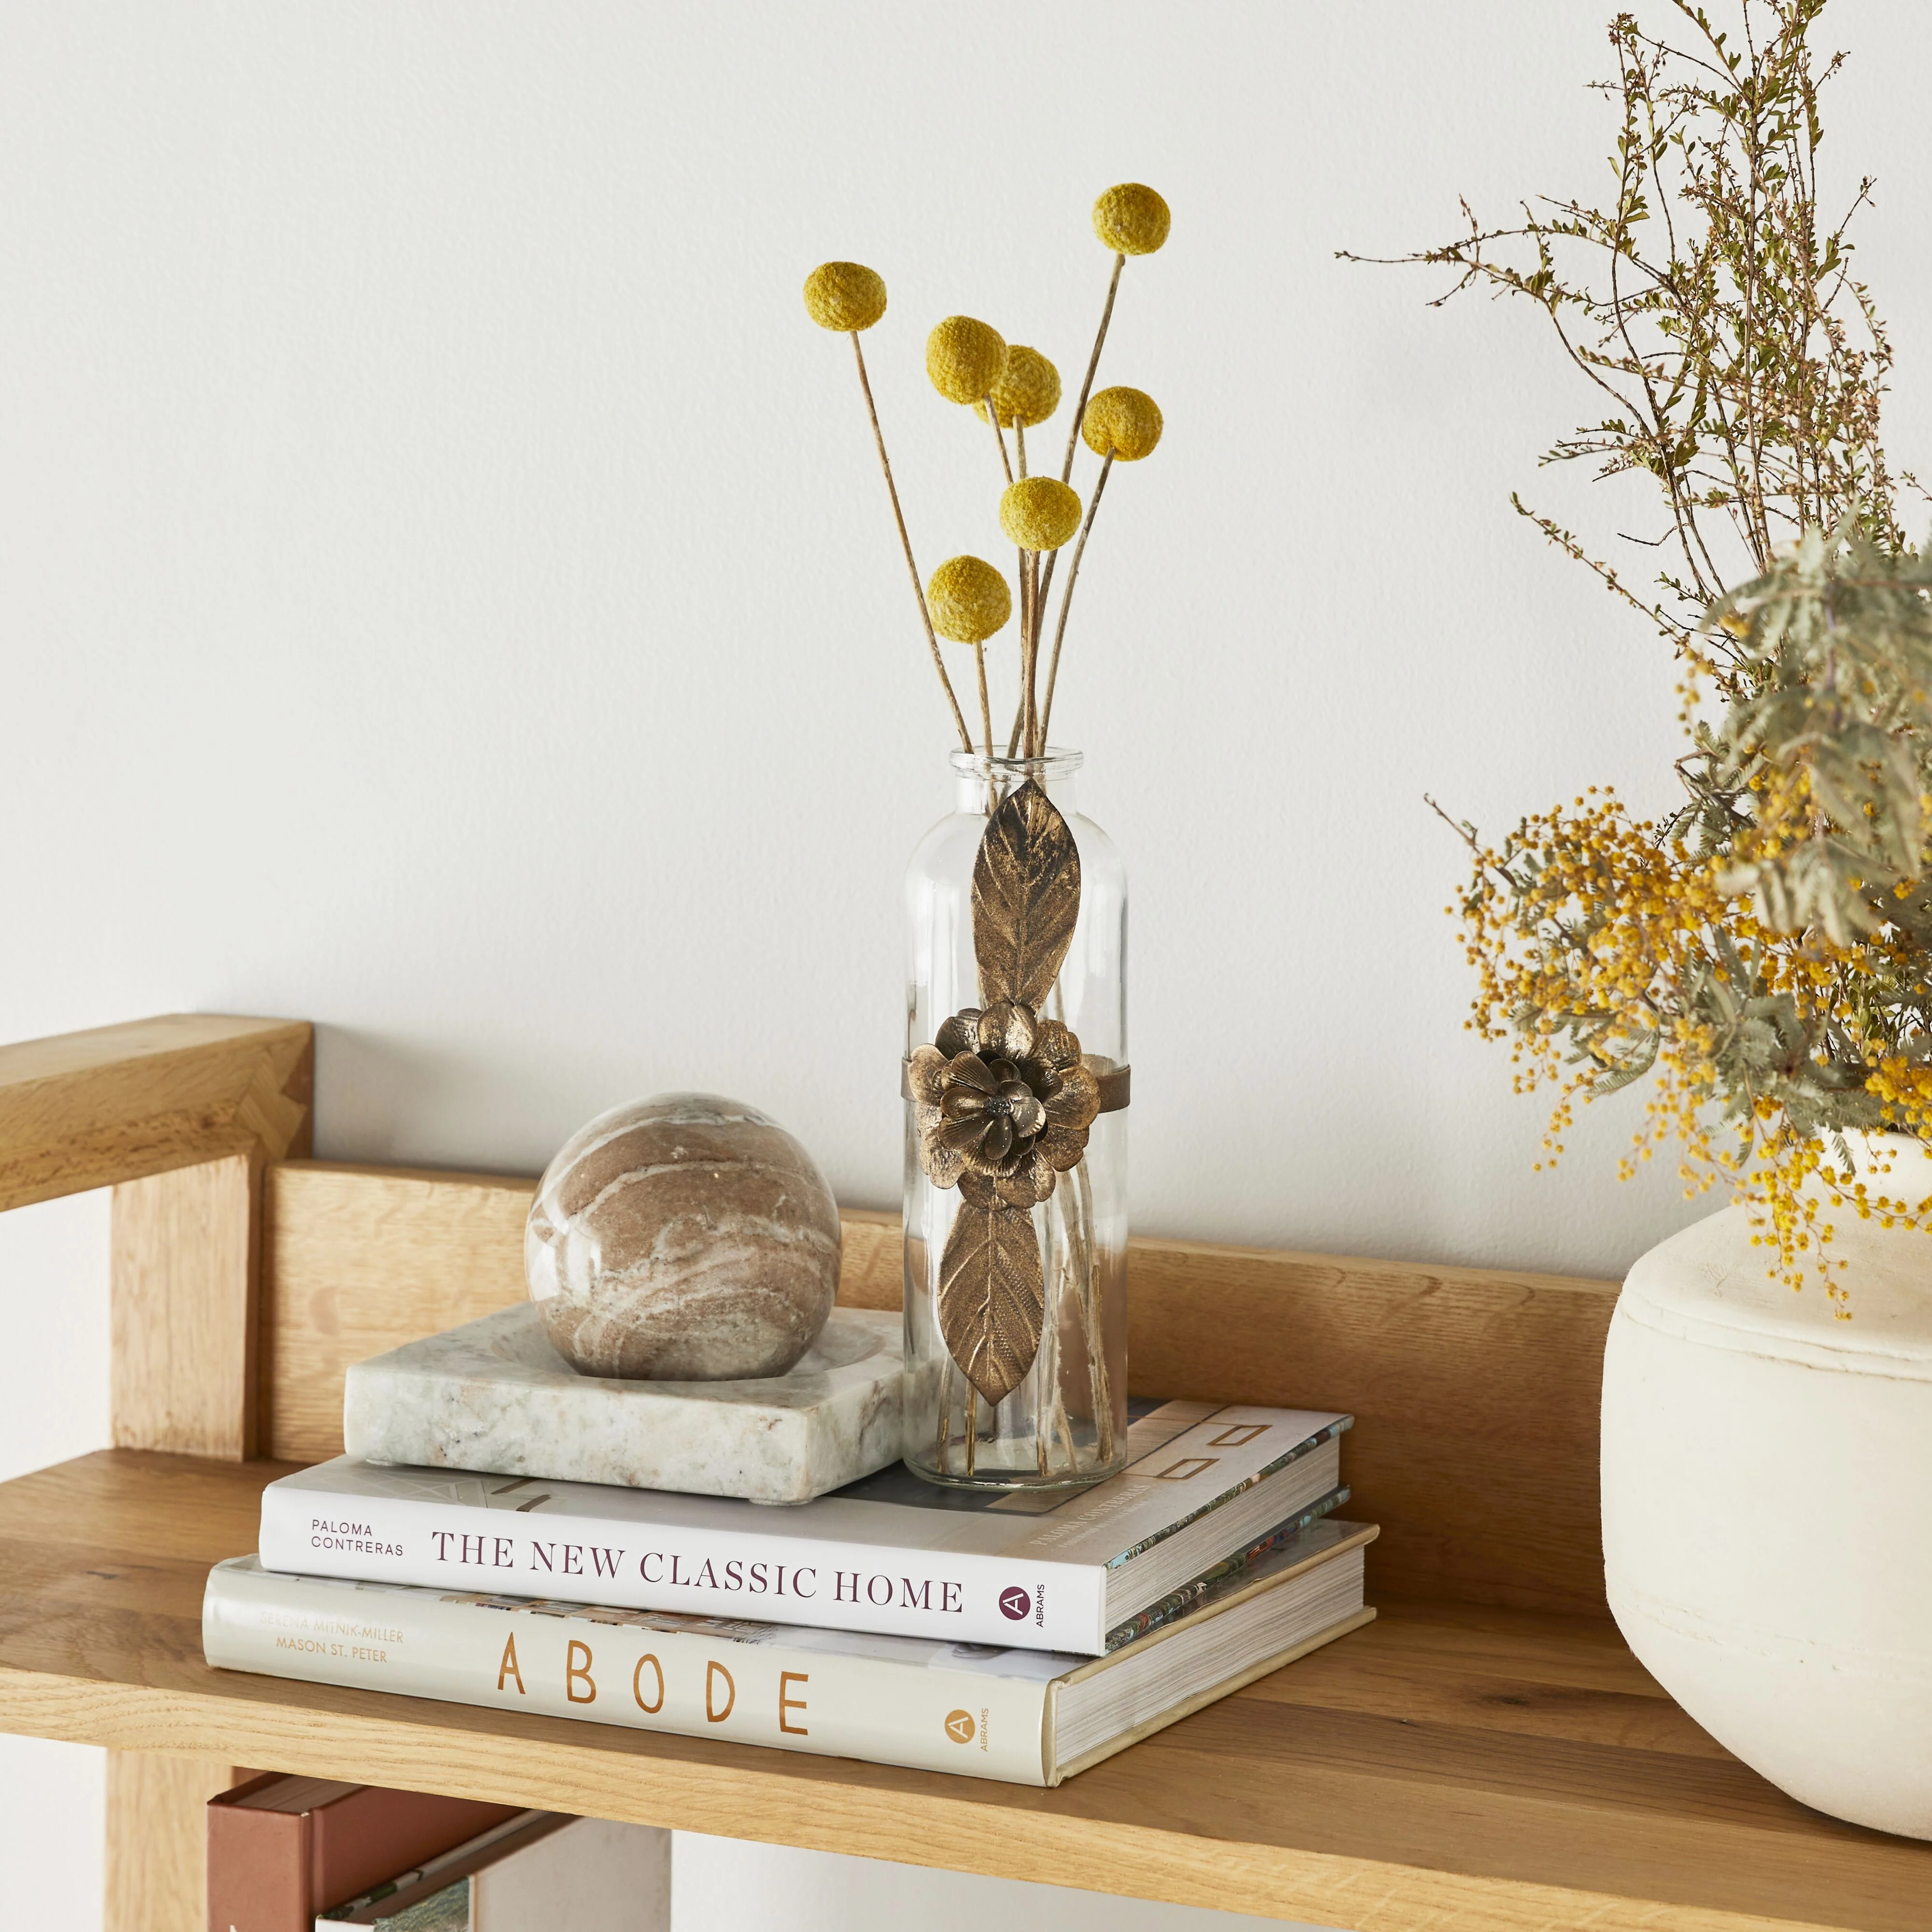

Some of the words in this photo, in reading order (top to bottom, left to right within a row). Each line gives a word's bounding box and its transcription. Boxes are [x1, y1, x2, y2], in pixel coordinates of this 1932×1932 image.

[312, 1519, 372, 1537] PALOMA
[1030, 1521, 1087, 1546] PALOMA
[1078, 1484, 1151, 1520] CONTRERAS
[311, 1536, 403, 1556] CONTRERAS
[431, 1531, 514, 1568] THE
[529, 1541, 626, 1579] NEW
[640, 1552, 817, 1598] CLASSIC
[833, 1571, 963, 1613] HOME
[261, 1611, 309, 1630] SERENA
[313, 1619, 404, 1644] MITNIK-MILLER
[1036, 1584, 1045, 1628] ABRAMS
[276, 1636, 326, 1654] MASON
[331, 1643, 348, 1657] ST.
[352, 1647, 387, 1663] PETER
[497, 1631, 810, 1736] ABODE
[980, 1708, 989, 1752] ABRAMS
